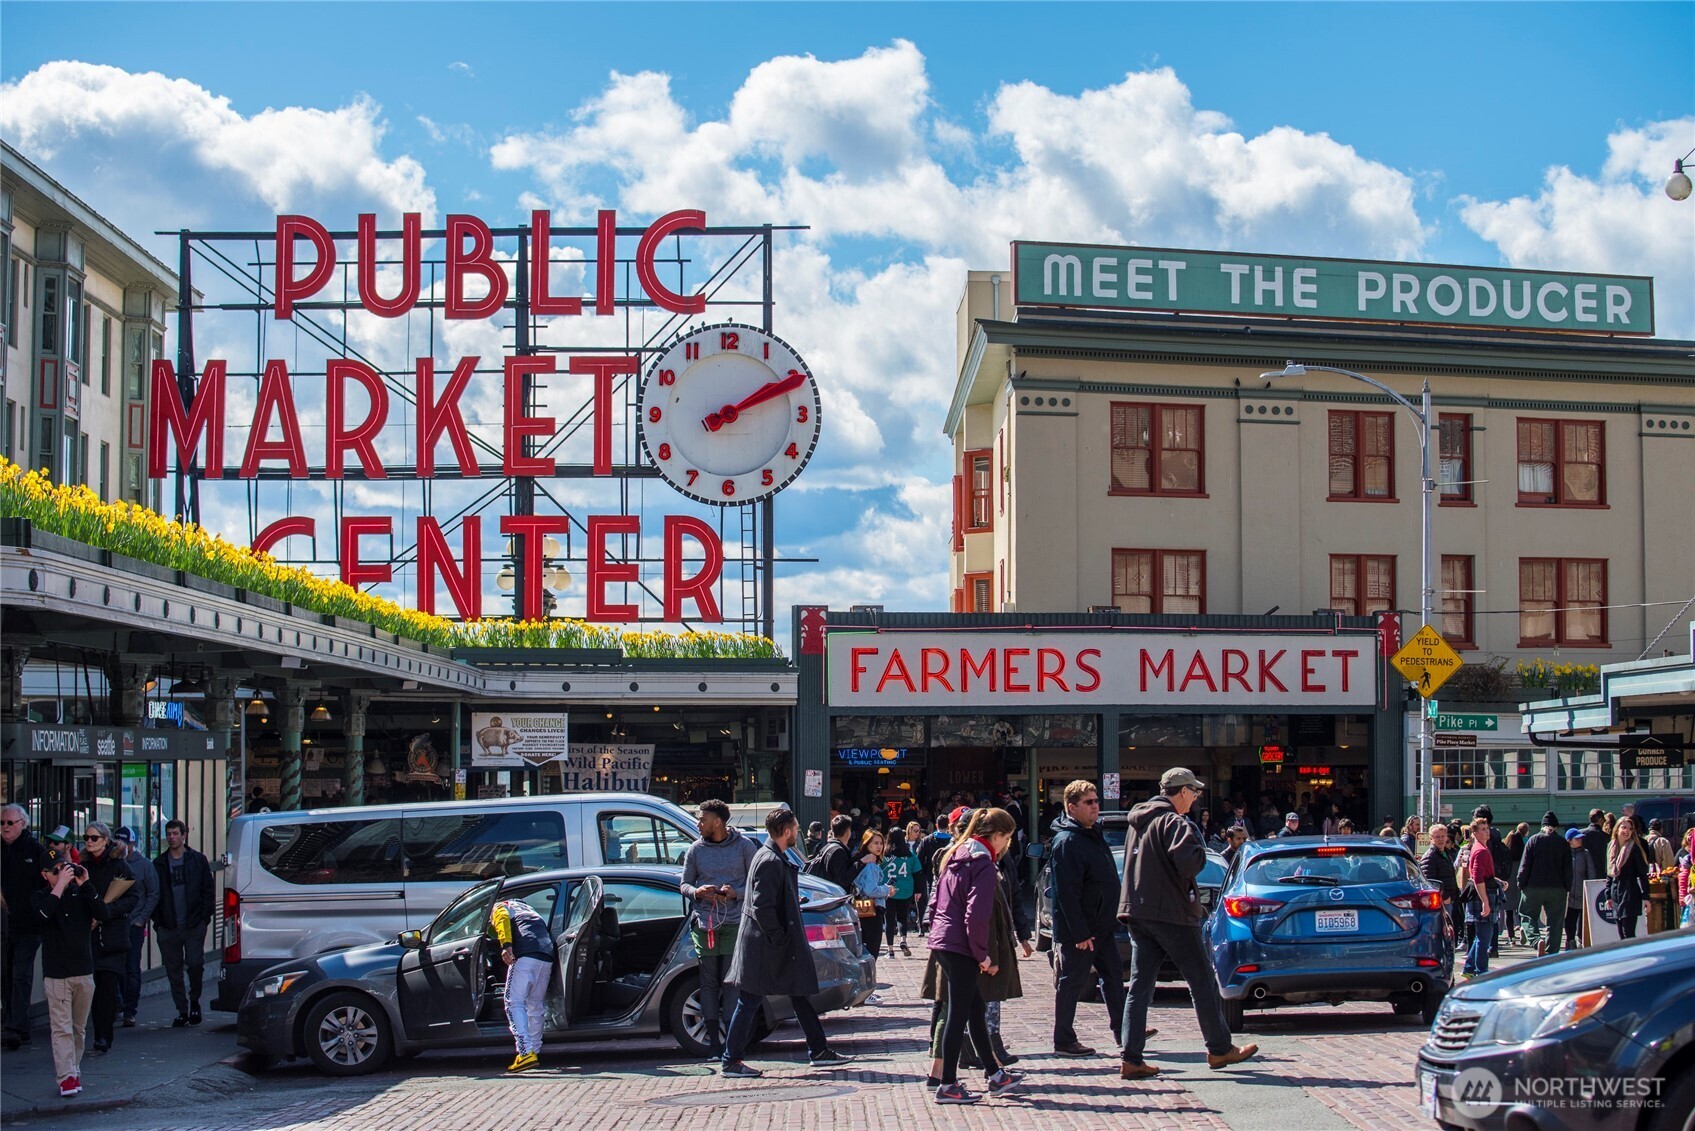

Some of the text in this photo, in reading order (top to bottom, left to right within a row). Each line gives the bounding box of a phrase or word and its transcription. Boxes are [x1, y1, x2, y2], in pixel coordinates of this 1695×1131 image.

[274, 209, 706, 320] PUBLIC
[1043, 253, 1633, 325] MEET THE PRODUCER
[720, 333, 739, 350] 12
[685, 342, 699, 360] 11
[763, 342, 769, 360] 1
[658, 369, 676, 386] 10
[149, 355, 638, 479] MARKET
[649, 406, 662, 423] 9
[796, 405, 808, 423] 3
[658, 443, 672, 460] 8
[784, 442, 799, 459] 4
[686, 469, 699, 486] 7
[761, 469, 774, 486] 5
[721, 479, 735, 496] 6
[1416, 637, 1440, 646] YIELD
[1422, 647, 1432, 656] TO
[850, 647, 1360, 693] FARMERS MARKET
[1400, 657, 1454, 666] PEDESTRIANS
[148, 701, 166, 719] CHASE
[511, 718, 565, 728] YOUR CHANGE
[1439, 715, 1463, 728] Pike
[31, 729, 80, 752] INFORMATION
[141, 737, 168, 750] INFORMATION
[568, 745, 584, 754] irst
[587, 744, 597, 754] of
[599, 745, 614, 754] the
[617, 746, 650, 755] Season
[838, 748, 908, 760] VIEWPT
[563, 756, 650, 770] Wild Pacific
[1635, 756, 1668, 766] PRODUCE
[562, 771, 649, 792] Halibut
[949, 771, 985, 784] LOWER
[49, 850, 56, 859] P
[887, 862, 908, 878] 24
